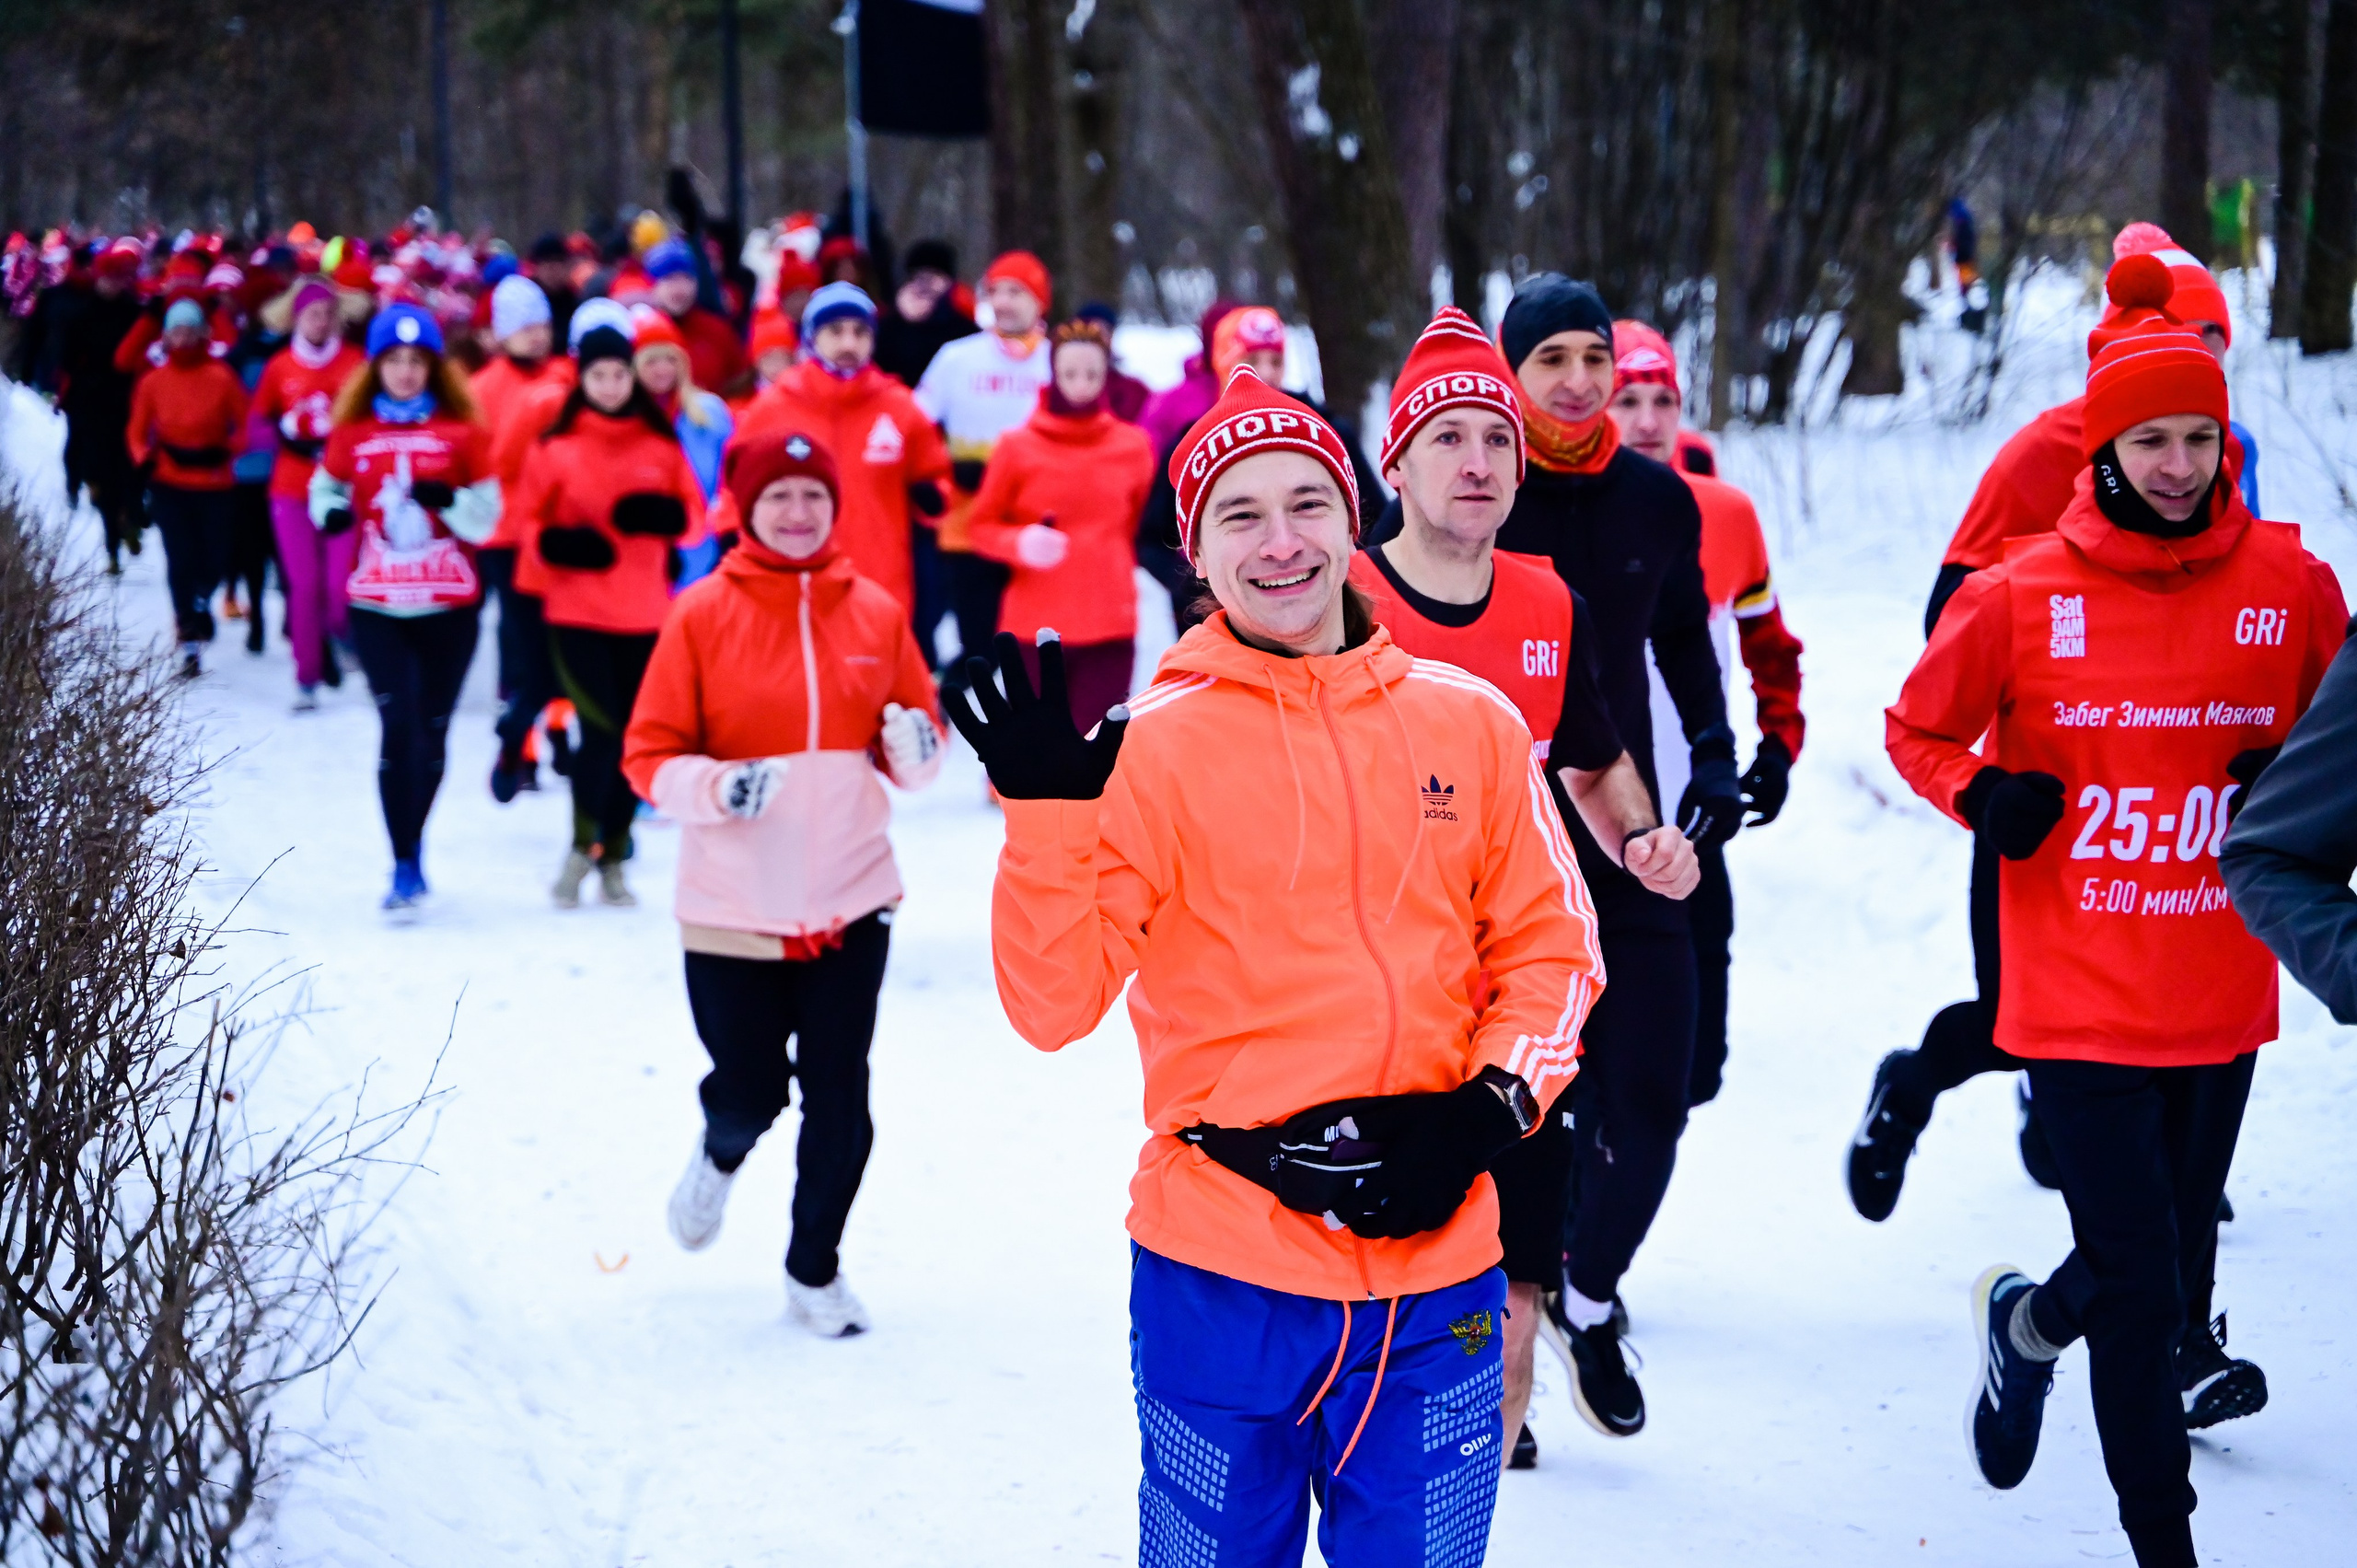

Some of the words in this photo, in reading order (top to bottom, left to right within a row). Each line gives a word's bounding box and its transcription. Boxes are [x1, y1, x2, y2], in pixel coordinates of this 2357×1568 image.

[1408, 377, 1513, 415] СПОРТ
[1190, 413, 1322, 480] СПОРТ
[2049, 594, 2084, 620] Sat
[2235, 607, 2289, 645] GRi
[2051, 617, 2085, 639] 9AM
[1522, 638, 1560, 677] GRi
[2049, 637, 2085, 658] 5KM
[2053, 701, 2114, 726] Забег
[2118, 700, 2201, 727] Зимних
[2204, 701, 2276, 726] Маяков
[2080, 877, 2138, 914] 5:00
[2141, 876, 2228, 917] мин/км
